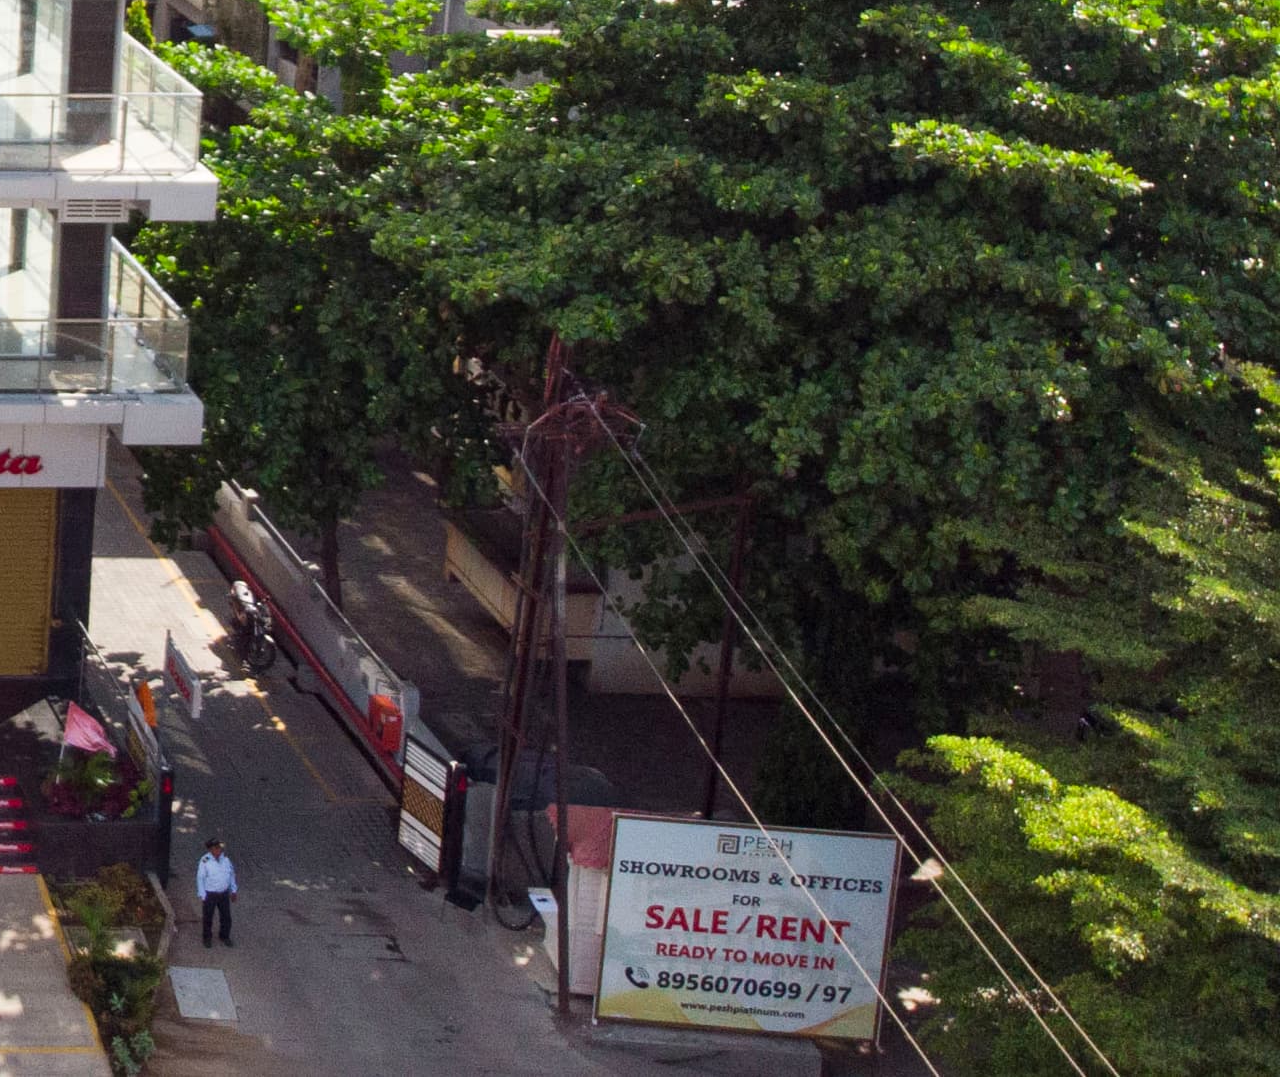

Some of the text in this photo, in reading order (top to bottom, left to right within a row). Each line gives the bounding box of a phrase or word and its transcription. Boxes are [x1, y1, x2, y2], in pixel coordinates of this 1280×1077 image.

[743, 835, 793, 853] PESH
[619, 860, 883, 894] SHOWROOMS & OFFICES
[732, 895, 761, 907] FOR
[645, 904, 729, 935] SALE
[756, 914, 851, 945] RENT
[656, 942, 835, 970] READY TO MOVE IN
[657, 971, 801, 999] 8956070699
[822, 986, 852, 1004] 97
